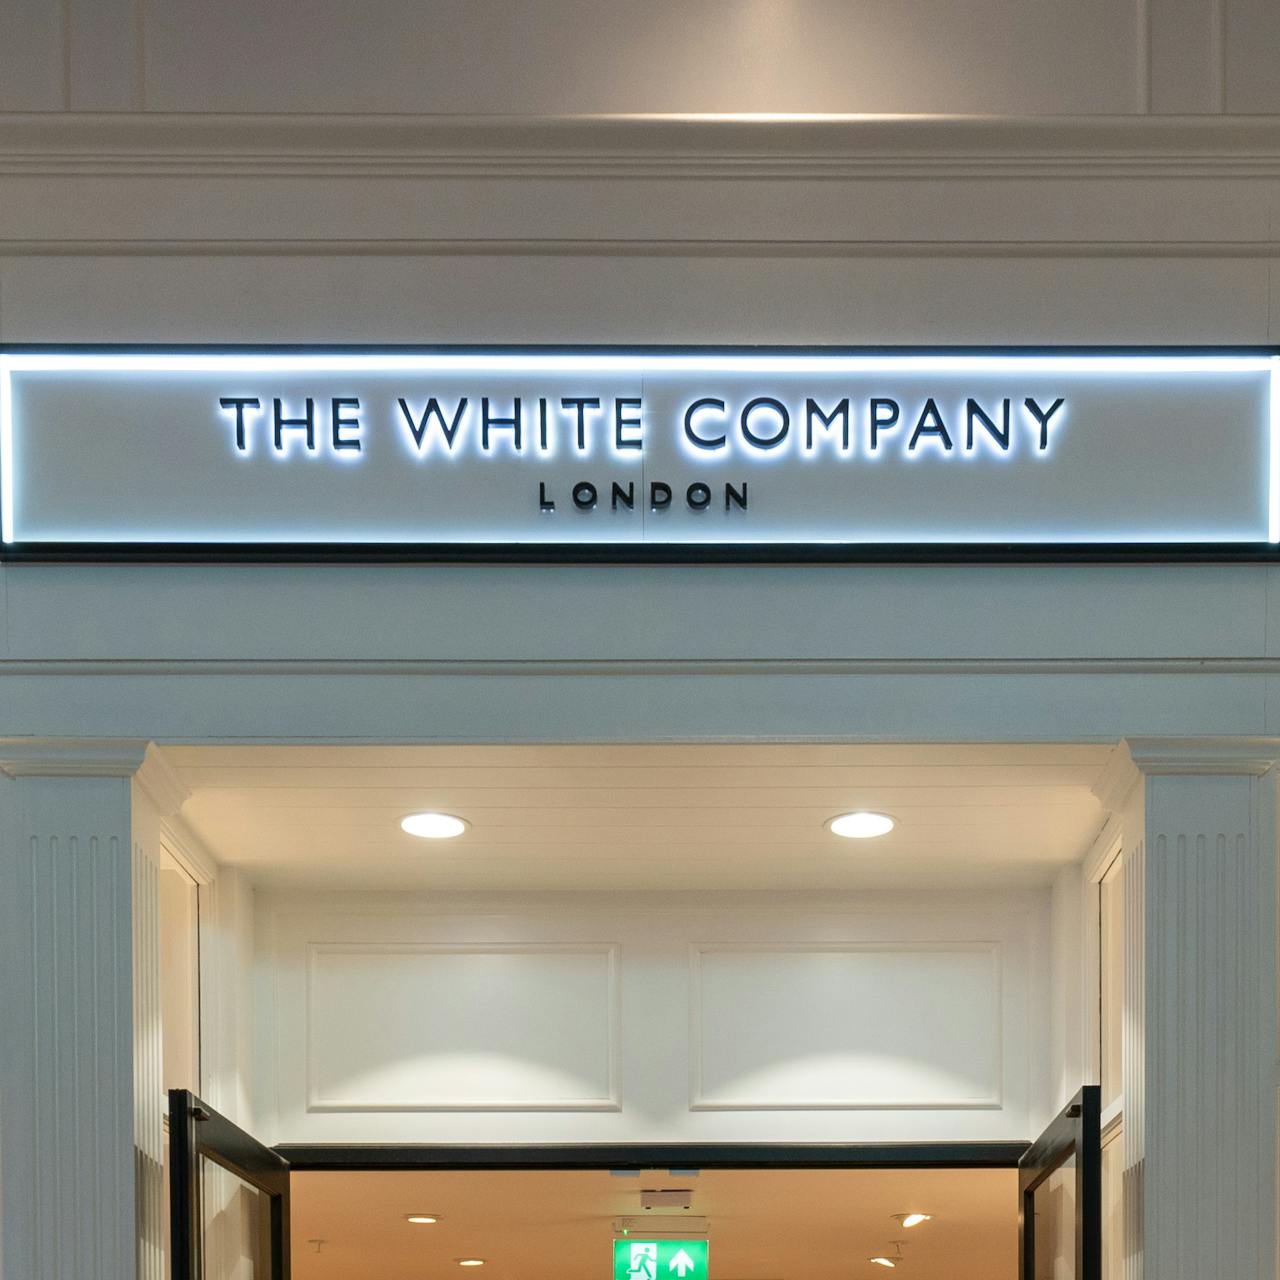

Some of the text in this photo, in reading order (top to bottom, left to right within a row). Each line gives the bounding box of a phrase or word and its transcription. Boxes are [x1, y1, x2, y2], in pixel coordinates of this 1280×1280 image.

[219, 396, 1066, 451] THE WHITE COMPANY
[539, 481, 749, 512] LONDON
